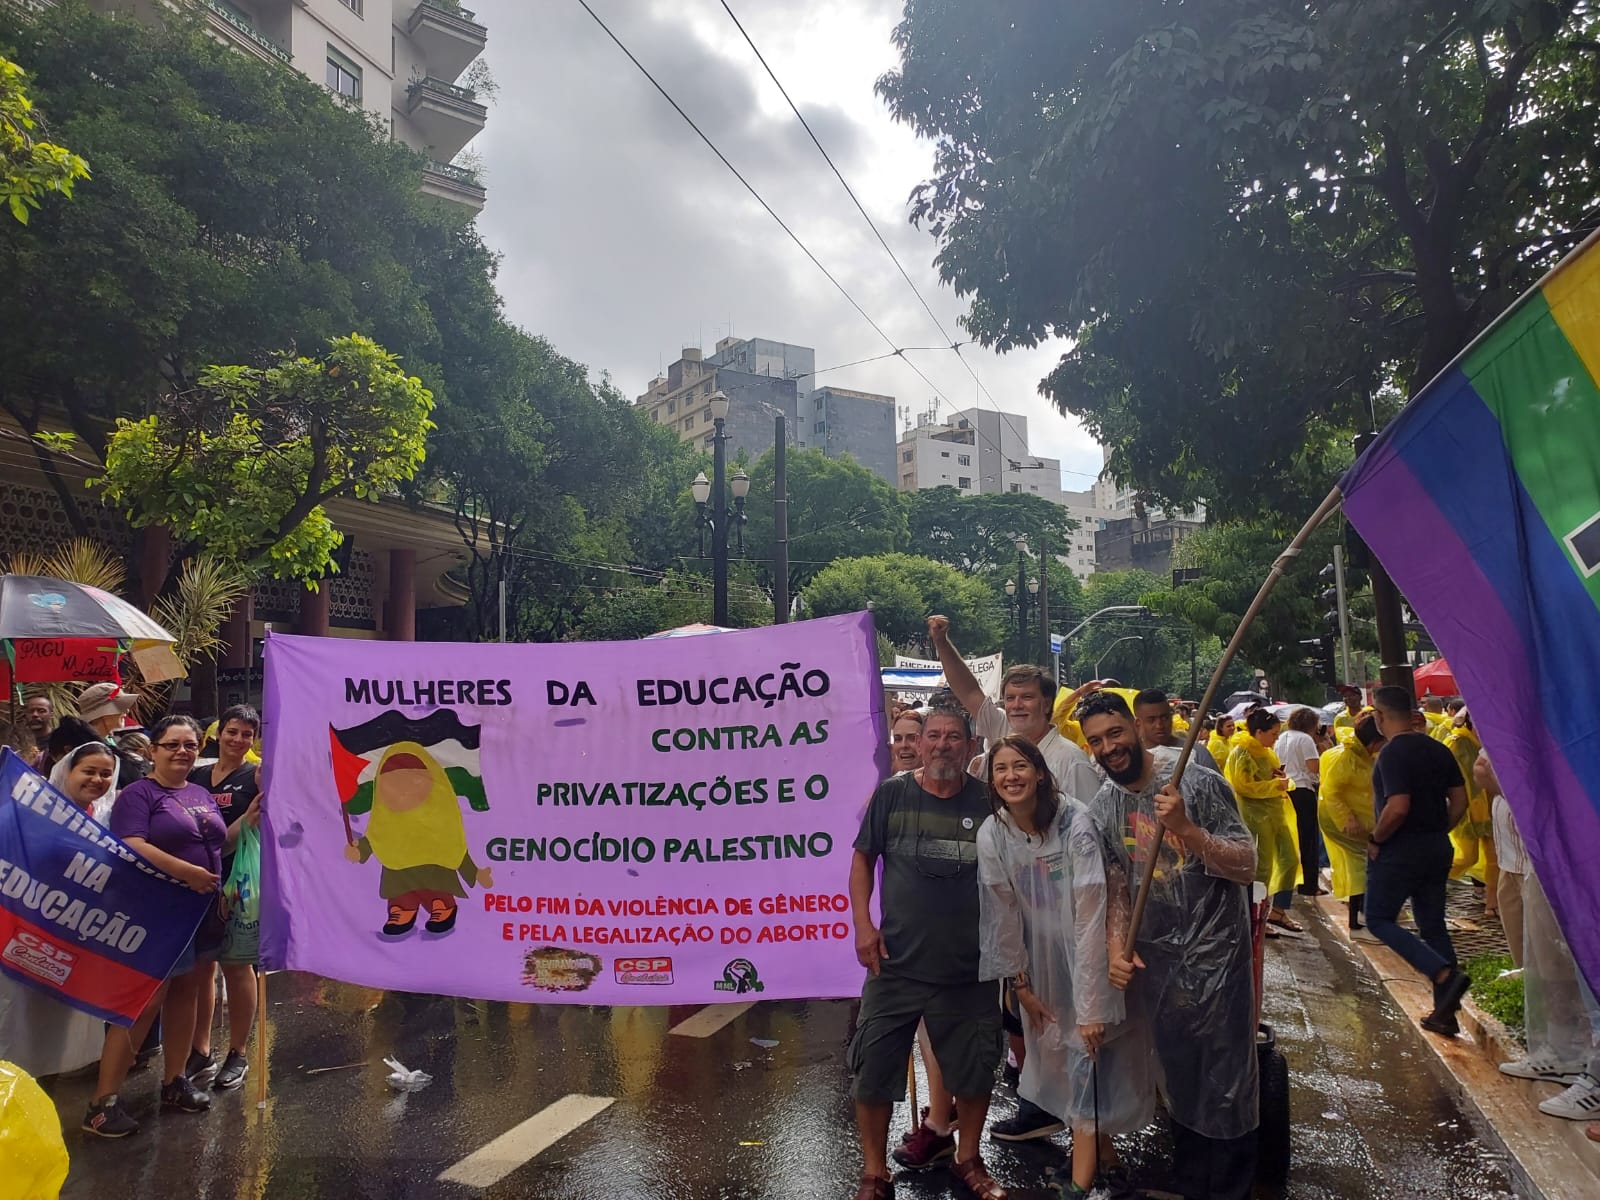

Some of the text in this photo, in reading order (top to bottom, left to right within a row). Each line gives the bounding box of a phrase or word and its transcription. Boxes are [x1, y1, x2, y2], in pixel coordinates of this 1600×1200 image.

[19, 639, 65, 659] PAGU
[62, 655, 77, 670] NA
[345, 662, 830, 708] MULHERES DA EDUCAÇÃO
[652, 719, 829, 752] CONTRA AS
[537, 774, 829, 811] PRIVATIZAÇÕES E O
[486, 831, 833, 863] GENOCÍDIO PALESTINO
[63, 851, 113, 893] NA
[0, 858, 147, 954] EDUCAÇÃO
[485, 893, 849, 916] PELO FIM DA VIOLÊNCIA DE GÊNERO
[17, 932, 73, 962] CSP
[503, 922, 849, 945] E PELA LEGALIZAÇÃO DO ABORTO
[618, 960, 668, 971] CSP
